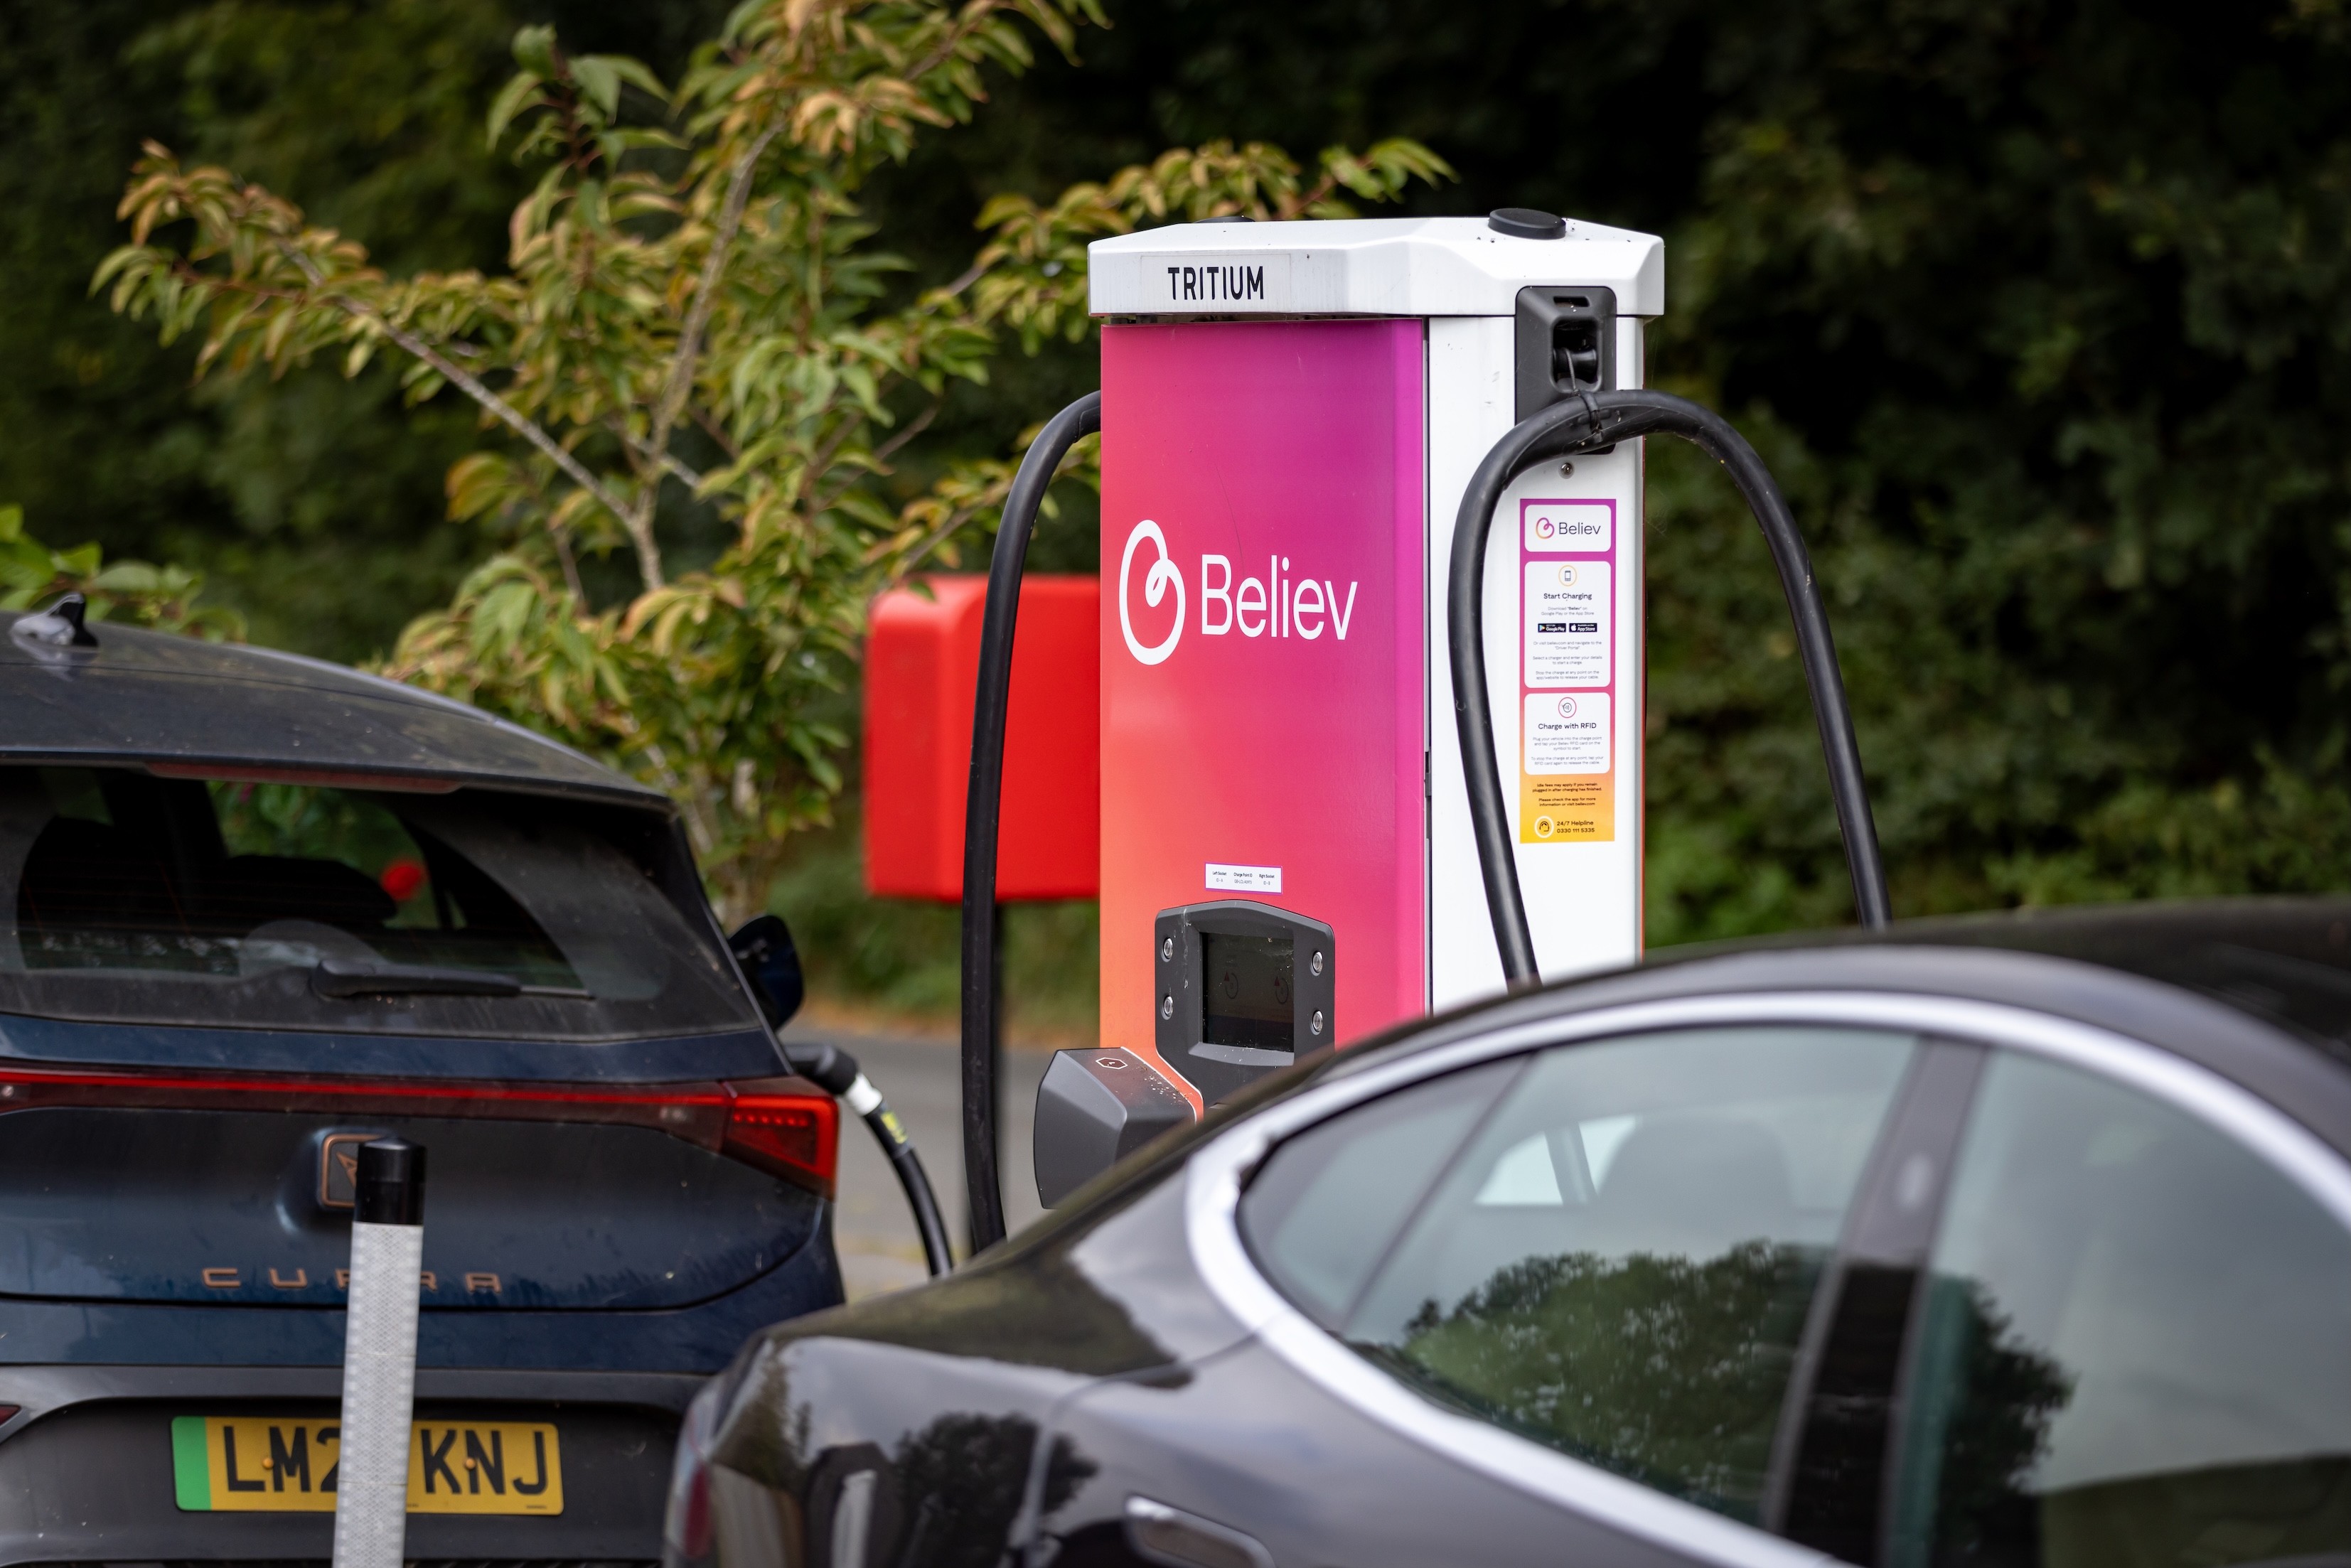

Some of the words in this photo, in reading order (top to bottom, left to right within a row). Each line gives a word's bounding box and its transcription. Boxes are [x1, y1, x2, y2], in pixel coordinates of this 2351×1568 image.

[1168, 266, 1264, 300] TRITIUM
[1559, 522, 1601, 535] Believ
[1201, 554, 1359, 640] Believ
[222, 1424, 339, 1493] LM2
[420, 1428, 549, 1496] KNJ
